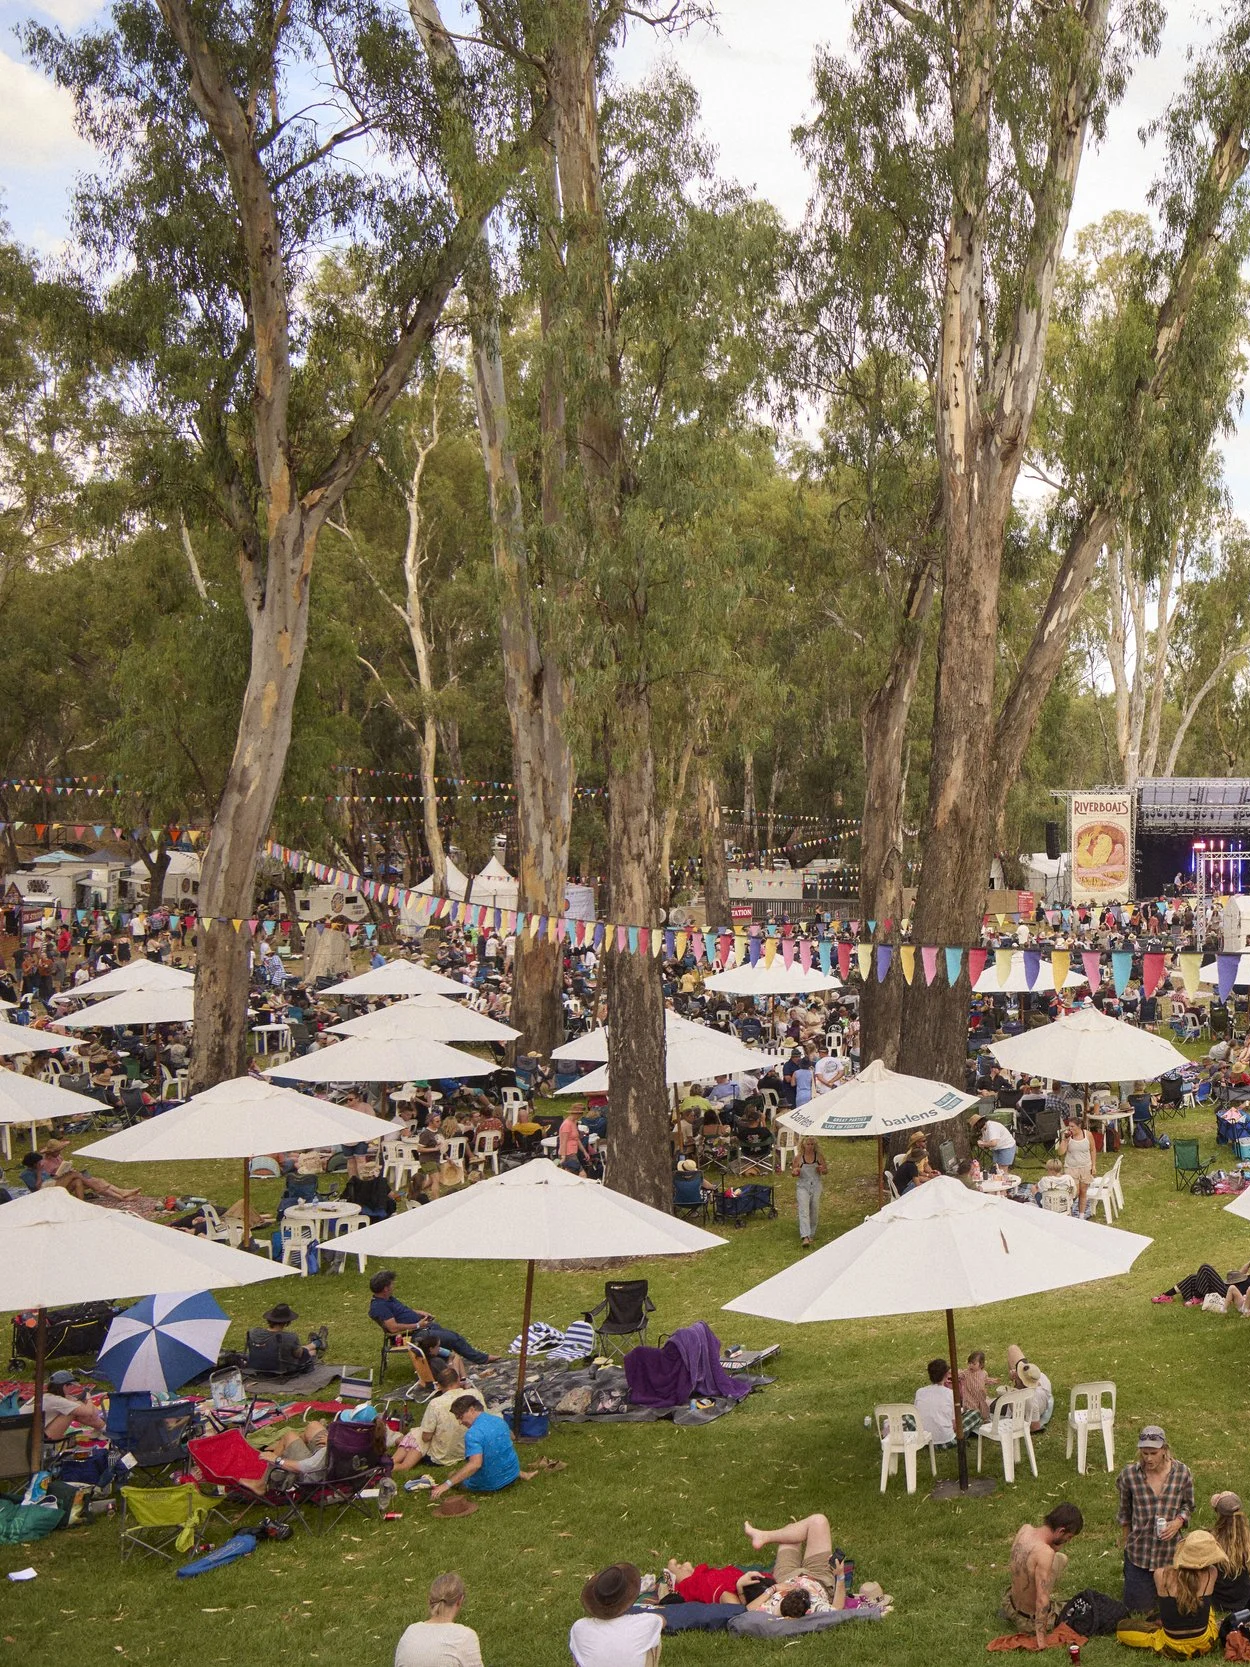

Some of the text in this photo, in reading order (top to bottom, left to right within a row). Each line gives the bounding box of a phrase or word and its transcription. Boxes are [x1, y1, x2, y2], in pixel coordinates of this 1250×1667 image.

[1074, 800, 1129, 815] RIVERBOATS
[731, 909, 752, 917] TATION
[881, 1108, 939, 1127] barlens
